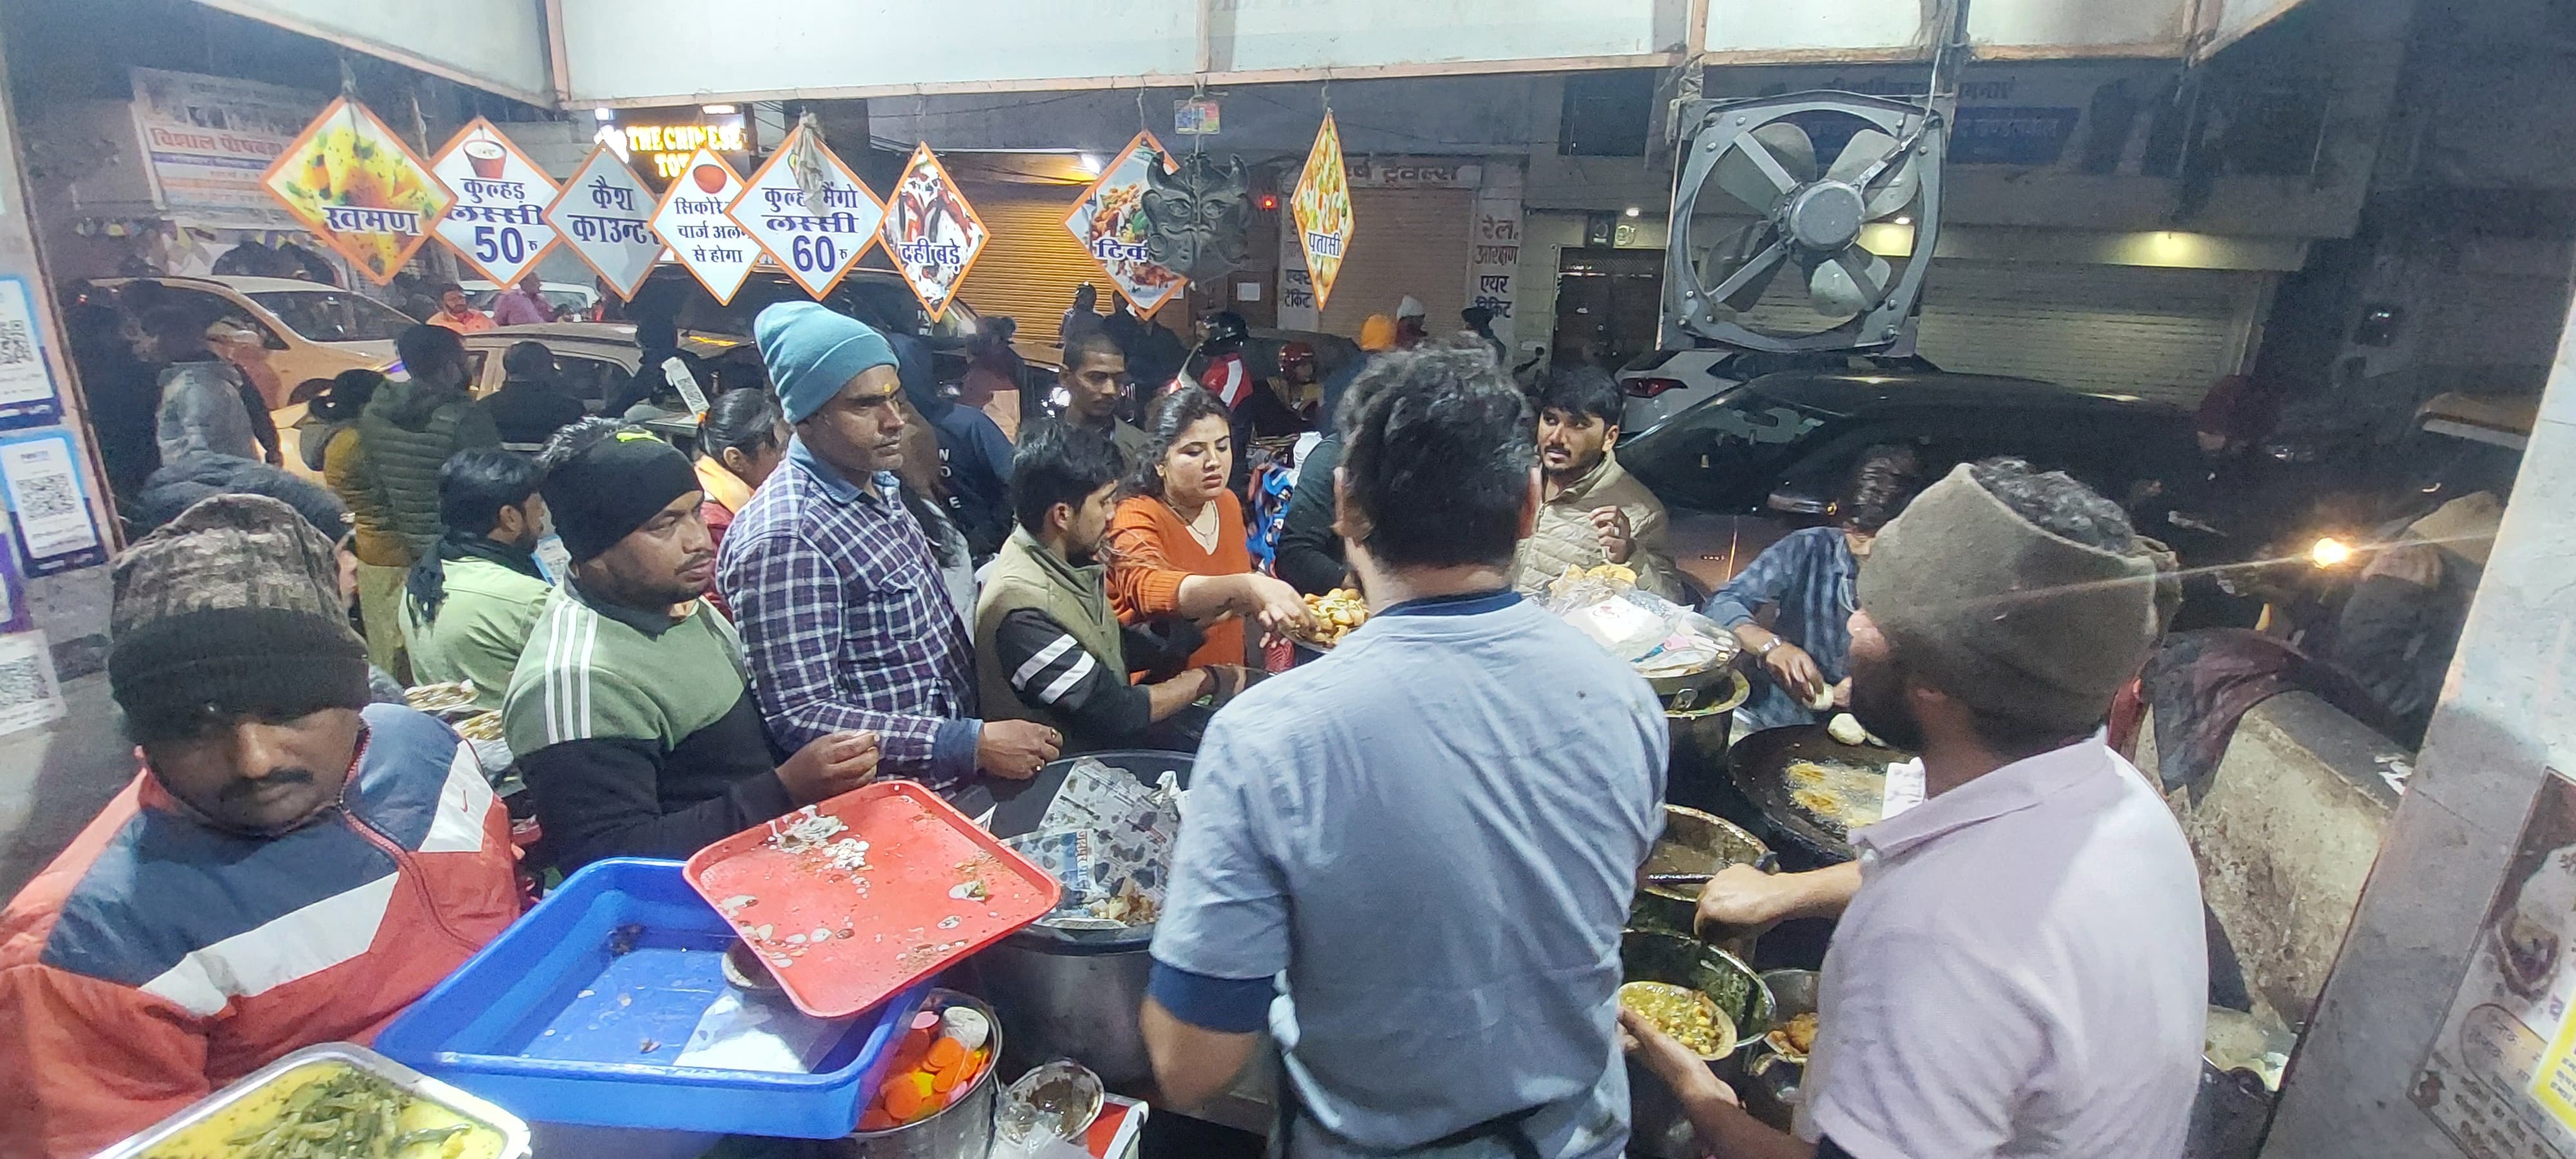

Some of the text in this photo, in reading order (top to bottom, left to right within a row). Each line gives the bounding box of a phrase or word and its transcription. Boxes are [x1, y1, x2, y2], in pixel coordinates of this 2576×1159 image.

[626, 126, 663, 151] THE
[460, 178, 525, 203] कुल्हड़
[588, 175, 634, 211] कैश
[761, 187, 806, 212] कुल्ह
[444, 205, 548, 225] लस्सी
[674, 196, 723, 214] सिकोरे
[677, 220, 709, 238] चार्ज
[761, 212, 859, 233] लस्सी
[475, 226, 524, 264] 50
[692, 245, 743, 263] से होगा
[793, 235, 835, 272] 60
[900, 238, 931, 263] दही
[1308, 232, 1341, 256] पतासी
[1481, 276, 1510, 293] एयर
